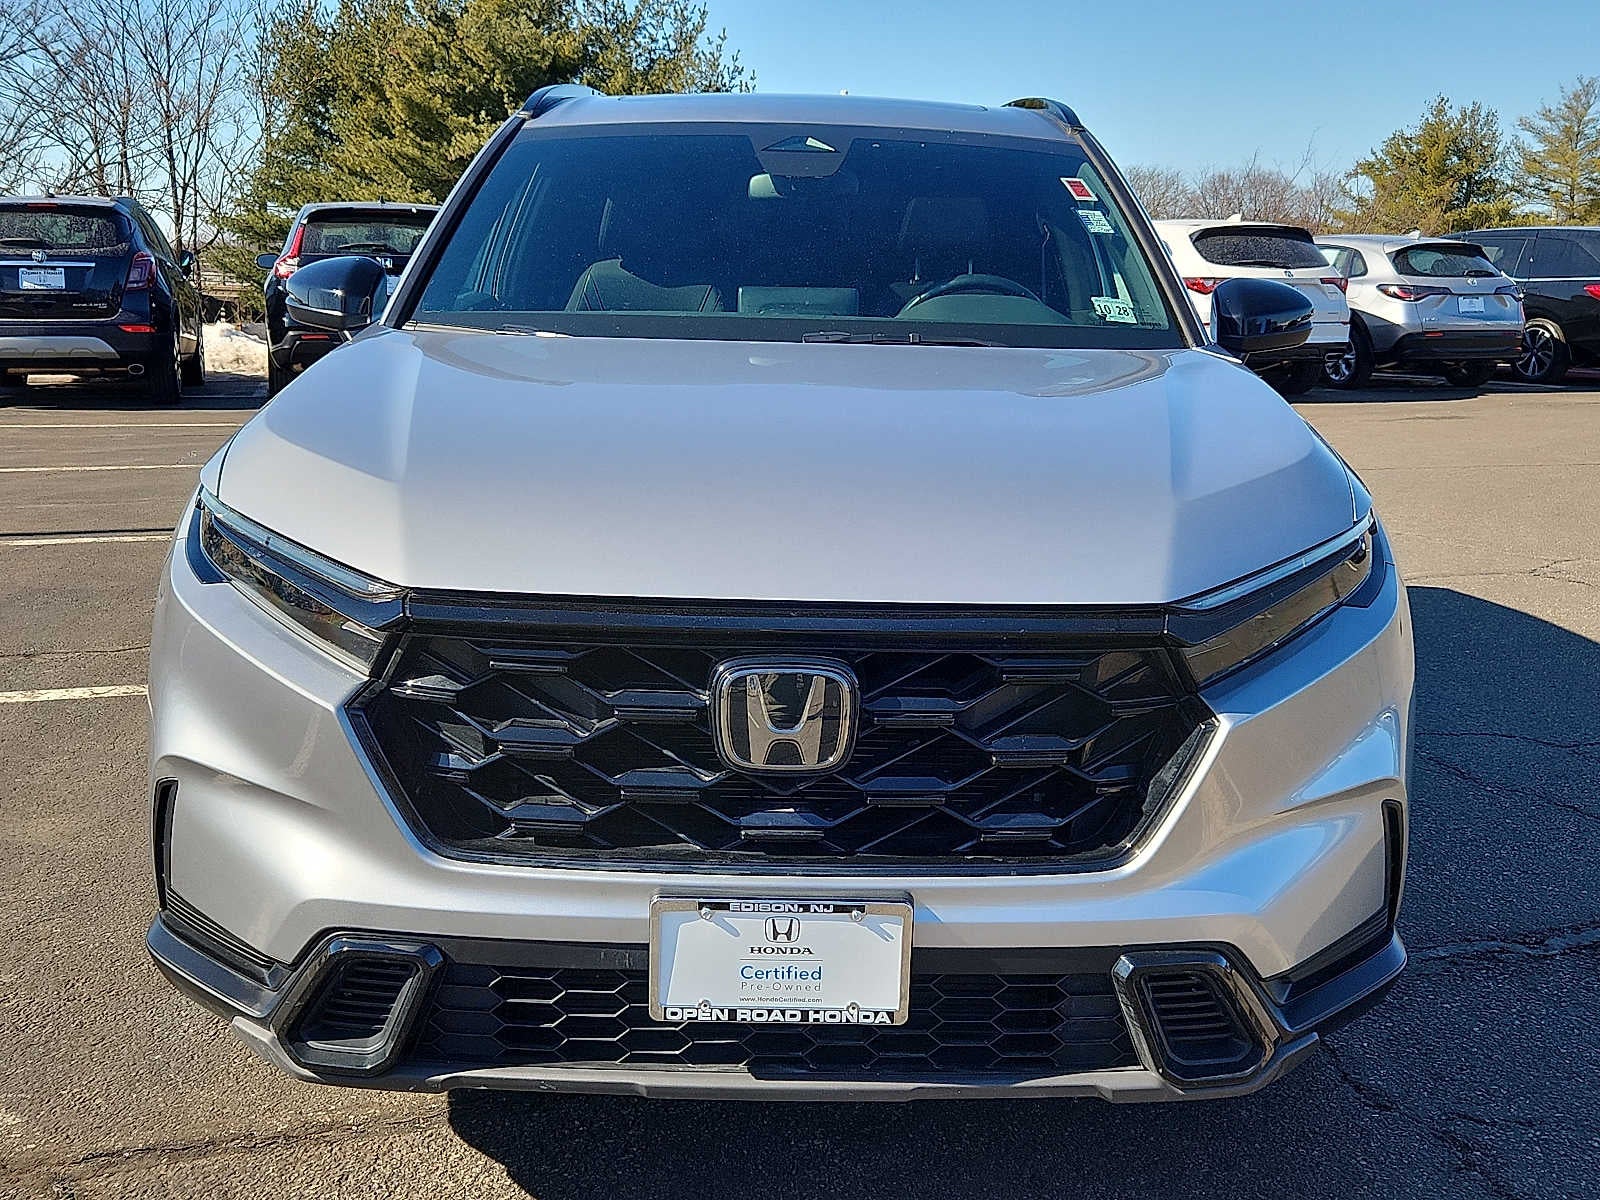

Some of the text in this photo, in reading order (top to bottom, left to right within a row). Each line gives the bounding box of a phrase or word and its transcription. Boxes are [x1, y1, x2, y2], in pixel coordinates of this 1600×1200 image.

[1097, 304, 1130, 317] 10 28
[729, 903, 835, 913] EDISON, NJ
[749, 946, 815, 955] HONDA
[740, 965, 822, 981] Certified
[740, 981, 822, 992] Pre-Owned
[739, 995, 823, 1004] www.HondaCertified.com
[665, 1007, 892, 1024] OPEN ROAD HONDA
